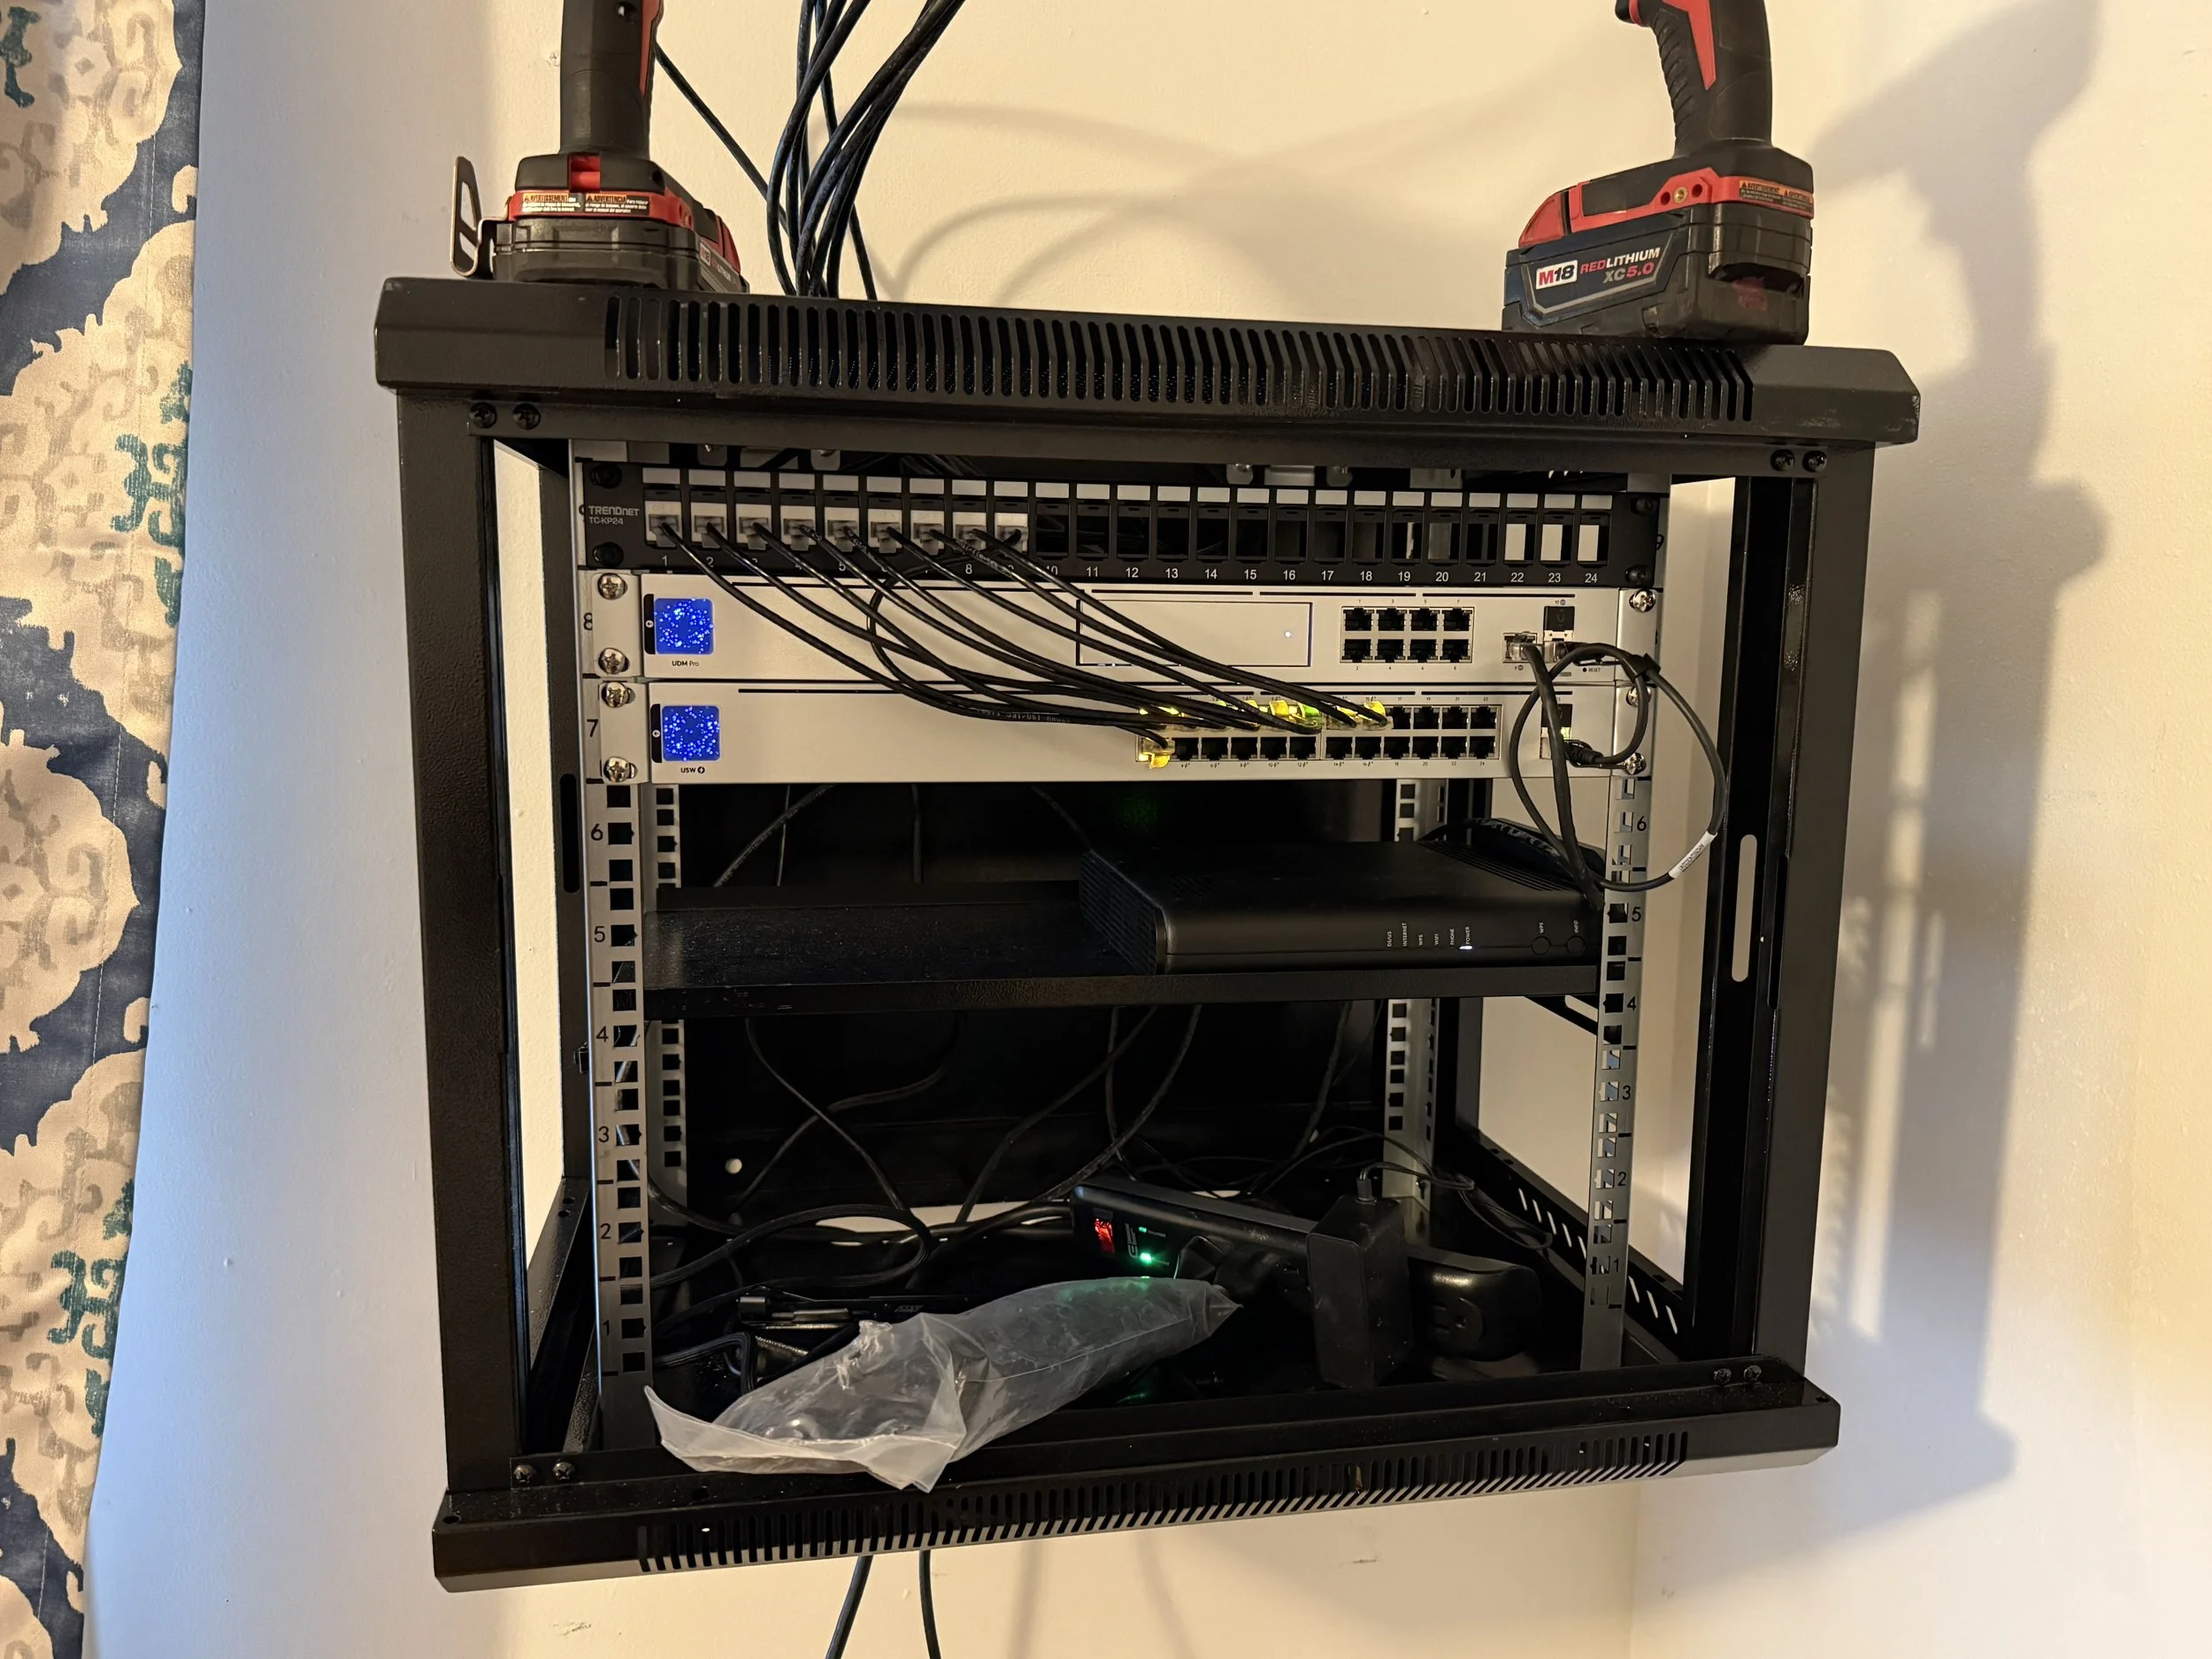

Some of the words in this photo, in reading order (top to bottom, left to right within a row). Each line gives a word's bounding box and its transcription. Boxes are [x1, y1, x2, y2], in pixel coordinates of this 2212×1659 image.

[1539, 265, 1574, 286] M18
[1579, 247, 1661, 274] REDLITHIUM
[662, 555, 669, 567] 1
[705, 556, 715, 568] 2
[964, 563, 973, 575] 8
[1086, 566, 1098, 577] 11
[1125, 566, 1139, 578] 12
[1165, 567, 1179, 579] 13
[1204, 568, 1217, 580] 14
[1244, 569, 1257, 580] 15
[1283, 569, 1296, 580] 16
[1321, 570, 1334, 581] 17
[1360, 571, 1372, 581] 18
[1398, 571, 1411, 582] 19
[1436, 571, 1449, 582] 20
[1473, 572, 1486, 582] 21
[1510, 572, 1525, 583] 22
[1548, 572, 1561, 583] 23
[1585, 572, 1598, 583] 24
[583, 611, 593, 631] 8
[587, 718, 599, 738] 7
[1637, 816, 1647, 831] 6
[591, 824, 603, 841] 6
[1632, 907, 1641, 922] 5
[595, 926, 605, 942] 5
[1627, 996, 1636, 1010] 4
[596, 1026, 608, 1042] 4
[1623, 1086, 1631, 1100] 3
[599, 1126, 609, 1142] 3
[1618, 1171, 1626, 1186] 2
[600, 1224, 611, 1239] 2
[1614, 1259, 1618, 1272] 1
[603, 1320, 610, 1335] 1
